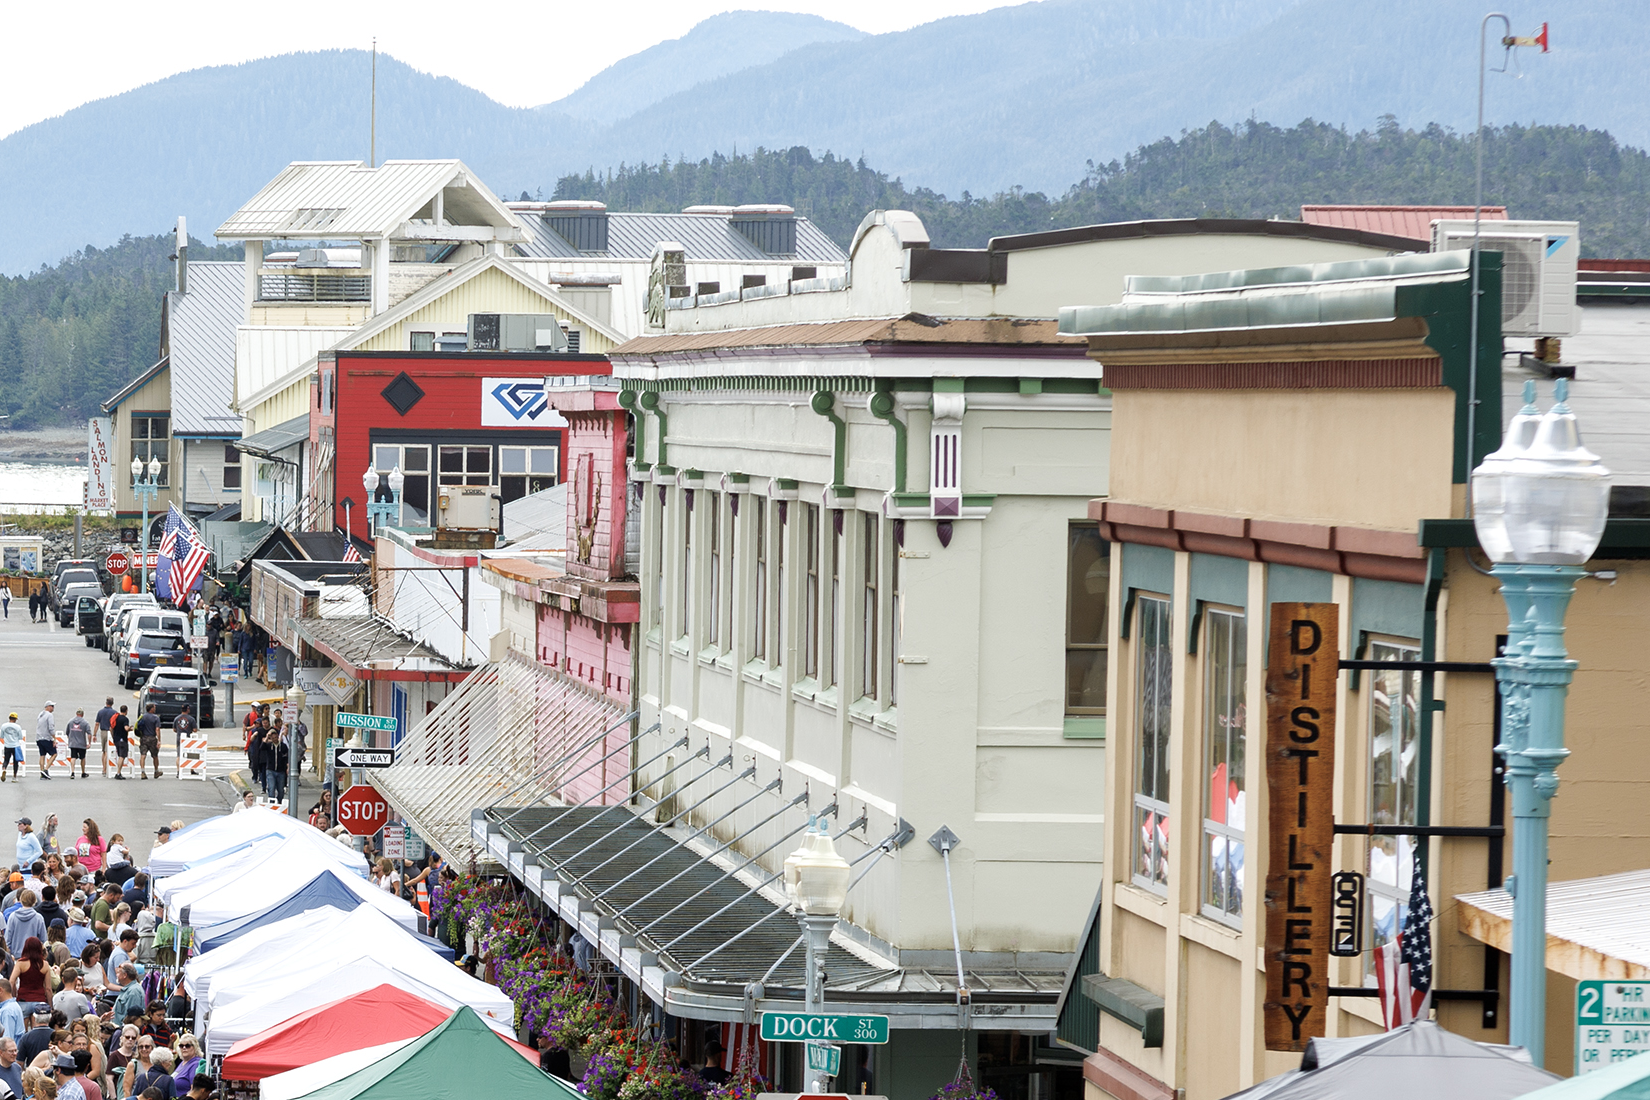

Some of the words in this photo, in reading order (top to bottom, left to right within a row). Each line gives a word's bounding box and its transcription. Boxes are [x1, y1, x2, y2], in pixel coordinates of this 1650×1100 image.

[93, 419, 108, 463] SALMON
[91, 447, 106, 497] LANDING
[107, 558, 128, 568] STOP
[338, 714, 382, 728] MISSION
[350, 754, 367, 763] ONE
[370, 754, 389, 763] WAY
[340, 800, 386, 820] STOP
[1281, 619, 1322, 1041] DISTILLERY
[1579, 986, 1600, 1018] 2
[1622, 987, 1643, 1003] HR
[1604, 1006, 1650, 1022] PARKIN
[773, 1016, 840, 1038] DOCK
[858, 1018, 875, 1030] ST
[854, 1029, 878, 1040] 300
[1588, 1028, 1612, 1044] PER
[1623, 1028, 1650, 1044] DAY
[1582, 1048, 1601, 1063] OR
